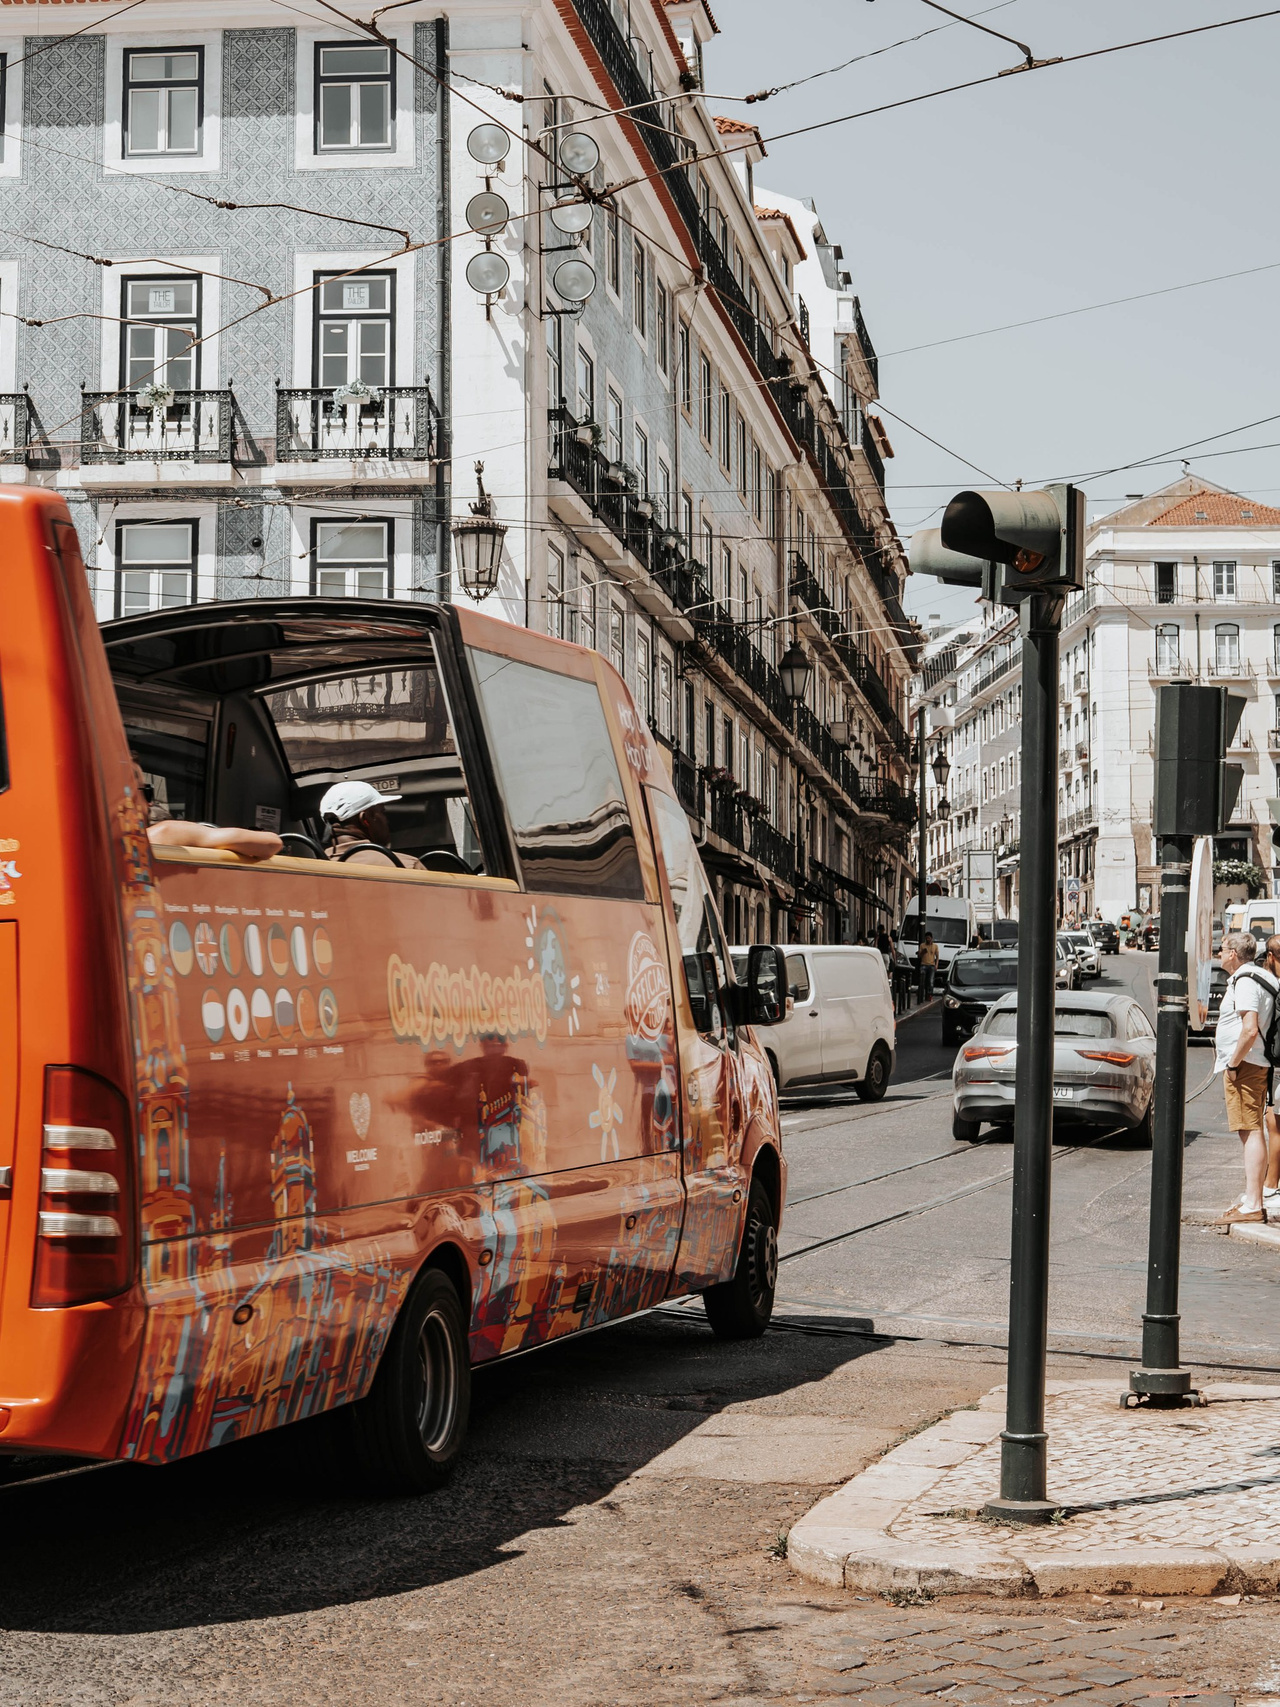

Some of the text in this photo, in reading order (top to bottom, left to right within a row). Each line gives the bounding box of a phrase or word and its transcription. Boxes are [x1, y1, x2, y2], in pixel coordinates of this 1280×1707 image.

[153, 290, 171, 302] THE
[347, 286, 365, 298] THE
[630, 967, 668, 1023] OFFICIAL
[648, 1000, 664, 1028] TOUR
[346, 1148, 378, 1163] WELCOME
